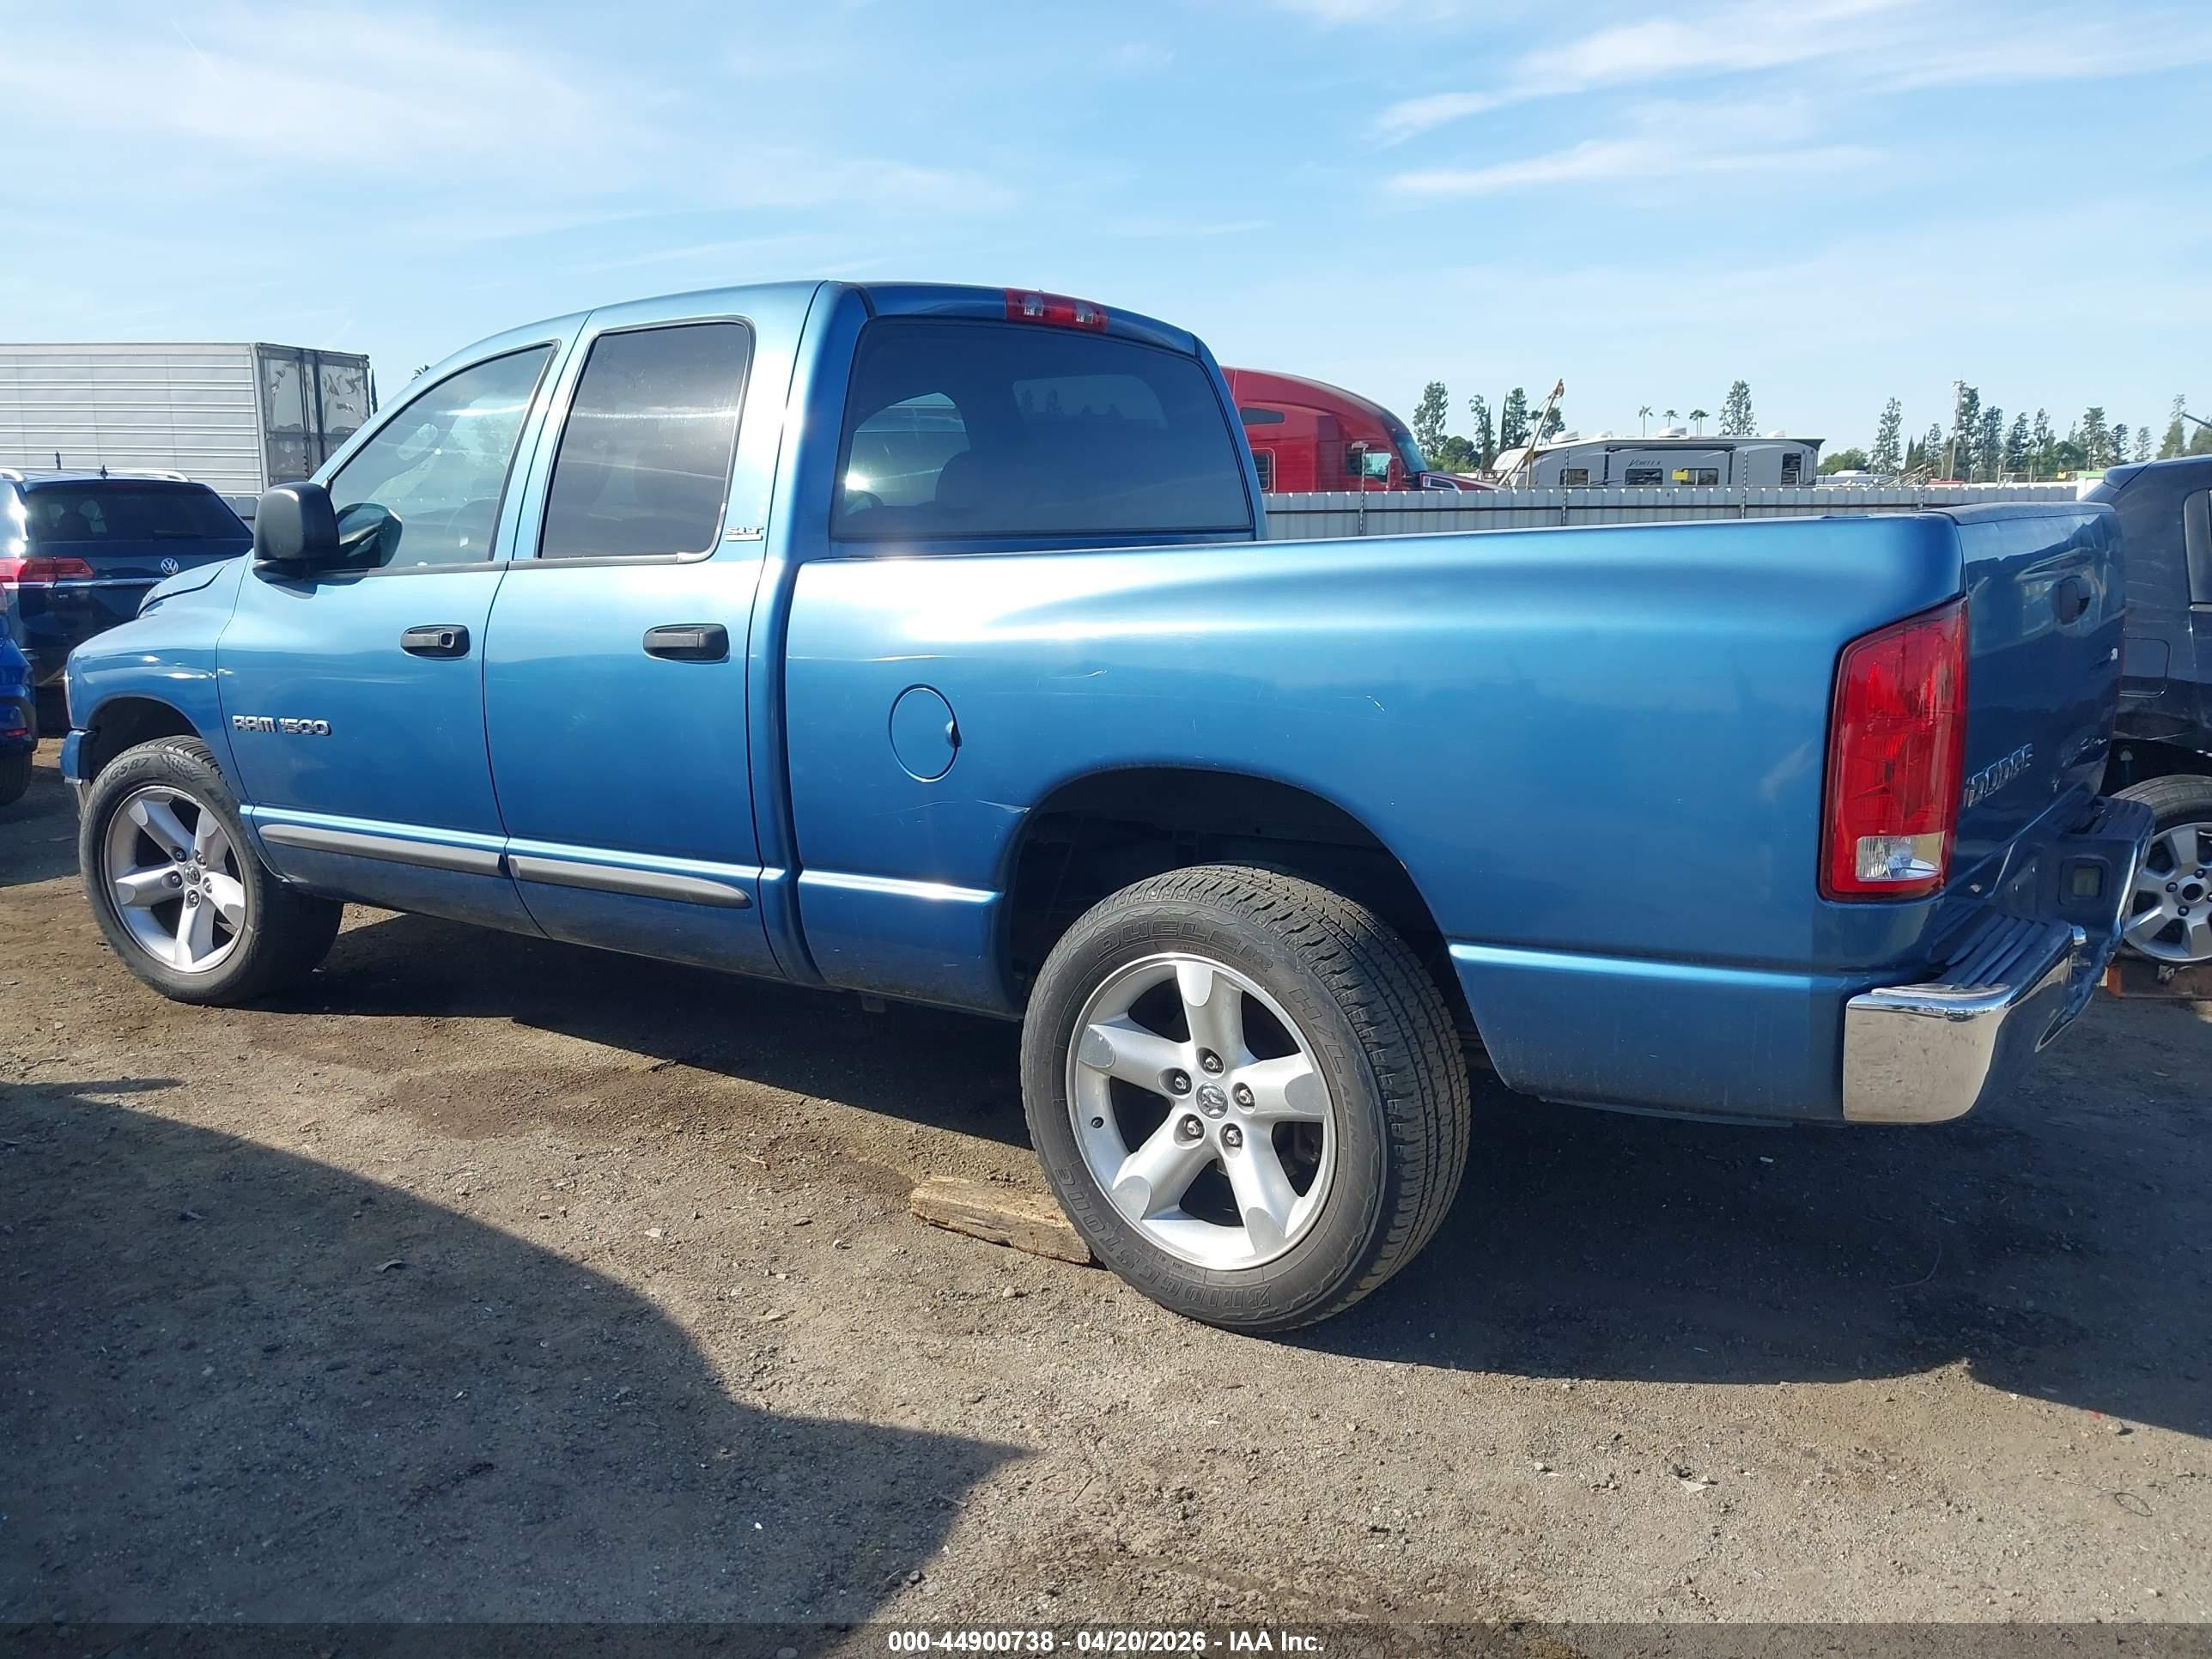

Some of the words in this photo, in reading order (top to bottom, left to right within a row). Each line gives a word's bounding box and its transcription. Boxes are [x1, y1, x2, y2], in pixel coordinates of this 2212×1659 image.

[232, 714, 277, 732] RAM
[278, 717, 331, 736] 1500
[1963, 743, 2033, 807] DODGE
[1096, 921, 1276, 974] DUELER
[1288, 988, 1346, 1073] H/L
[1054, 1168, 1272, 1308] BRIDGESTONE
